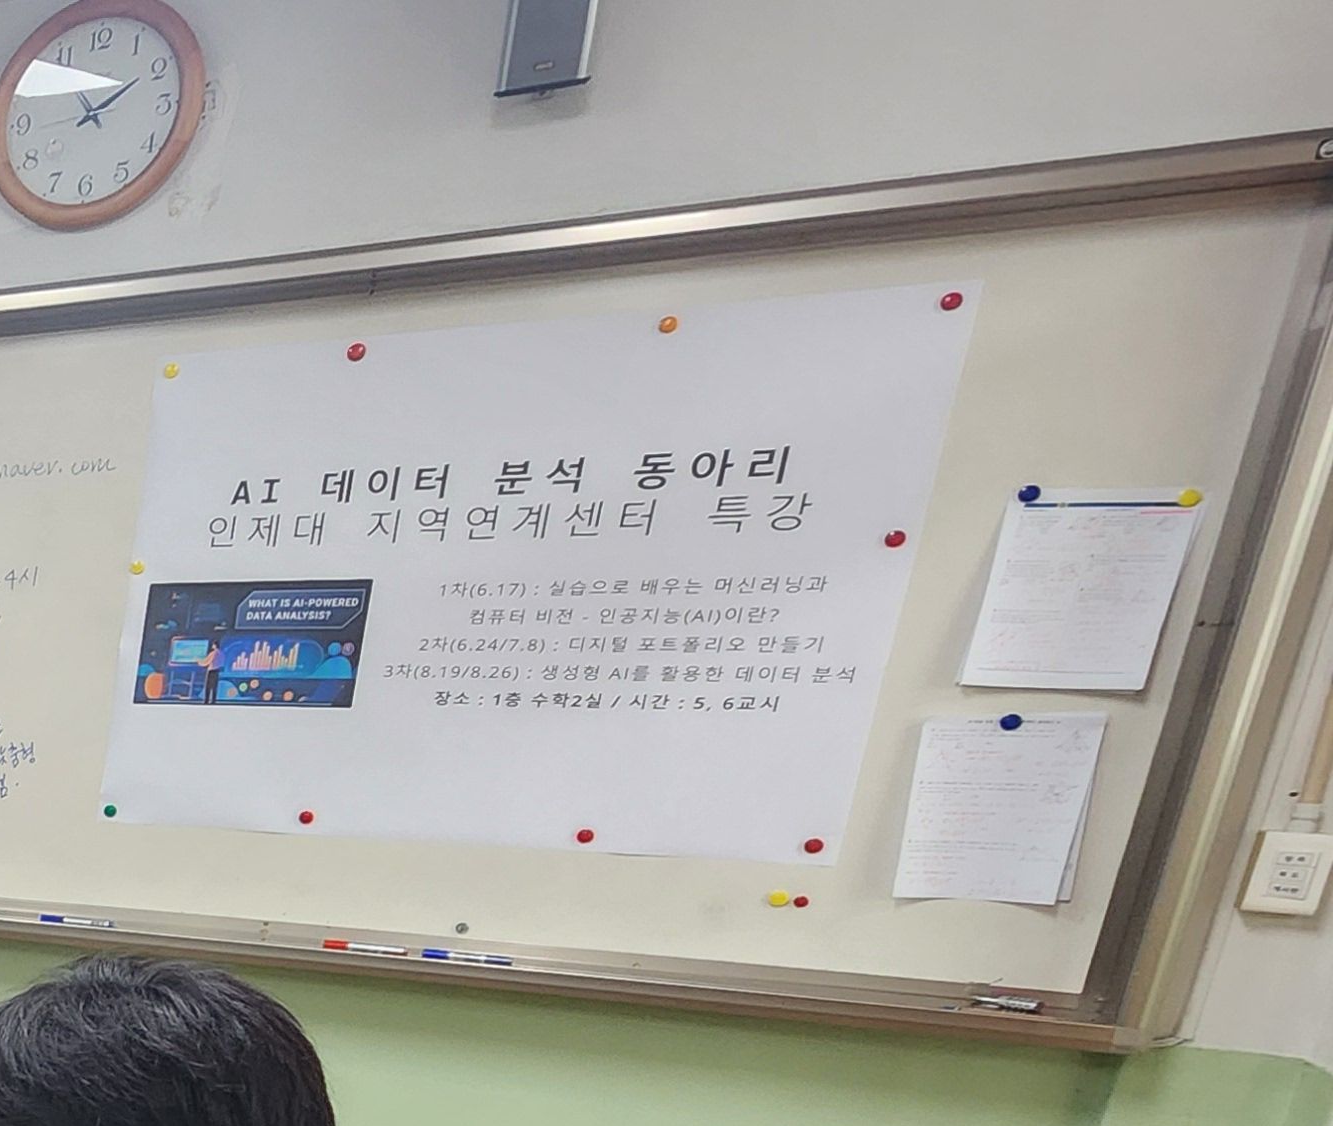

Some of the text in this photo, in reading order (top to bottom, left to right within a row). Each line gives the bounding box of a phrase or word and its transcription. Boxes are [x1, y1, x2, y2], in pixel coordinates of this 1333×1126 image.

[89, 26, 113, 53] 12
[131, 33, 141, 56] 1
[150, 58, 168, 81] 2
[155, 92, 173, 116] 3
[14, 113, 32, 136] 9
[140, 132, 159, 154] 4
[22, 148, 39, 170] 8
[49, 171, 64, 194] 7
[113, 160, 131, 183] 5
[77, 174, 93, 197] 6
[230, 445, 791, 505] AI 데이터 분석 동아리
[208, 492, 813, 548] 인제대 지역연계센터 특강
[438, 581, 527, 599] 1차(6.17)
[548, 579, 630, 597] 실습으로
[640, 578, 704, 595] 배우는
[714, 575, 828, 594] 머신러닝과
[247, 598, 359, 608] WHAT IS AI-POWERED
[245, 610, 331, 621] DATA ANALYSIS?
[469, 608, 526, 626] 컴퓨터
[534, 608, 575, 625] 비전
[598, 606, 781, 625] 인공지능(AI)이란?
[417, 636, 547, 654] 2차(6.24/7.8)
[567, 636, 628, 653] 디지털
[636, 635, 746, 653] 포트폴리오
[757, 635, 825, 654] 만들기
[382, 663, 520, 681] 3차(8.19/8.26)
[540, 665, 601, 681] 생성형
[607, 665, 651, 682] AI를
[660, 665, 725, 683] 활용한
[735, 666, 801, 684] 데이터
[811, 666, 857, 684] 분석
[433, 691, 470, 707] 장소
[492, 693, 522, 708] 1층
[531, 691, 603, 709] 수학2실
[628, 693, 671, 711] 시간
[692, 696, 713, 712] 5,
[722, 694, 781, 713] 6교시
